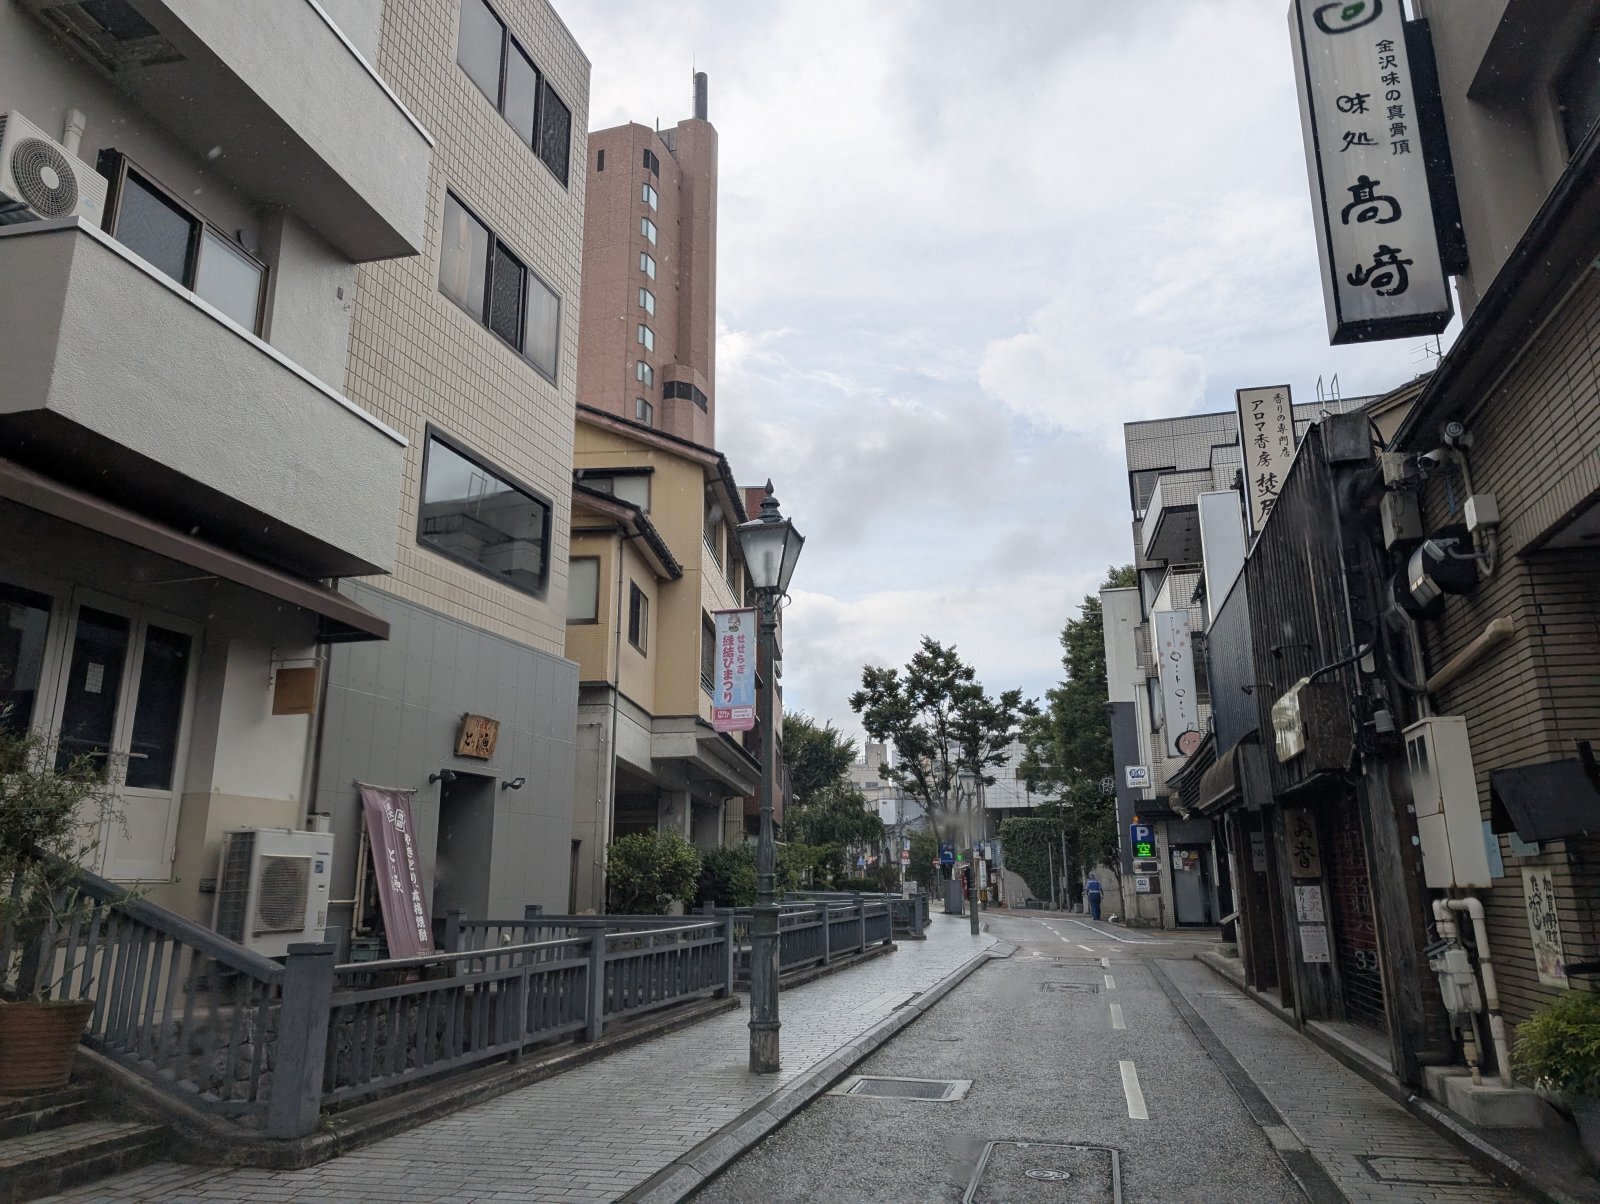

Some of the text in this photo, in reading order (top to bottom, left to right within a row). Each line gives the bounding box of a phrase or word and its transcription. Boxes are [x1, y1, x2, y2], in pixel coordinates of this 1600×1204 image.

[1375, 39, 1411, 156] 金沢味の真骨頂
[722, 635, 735, 703] 縁結びまつり
[736, 634, 746, 675] せせらぎ
[1136, 826, 1150, 841] P
[1136, 843, 1151, 857] 空
